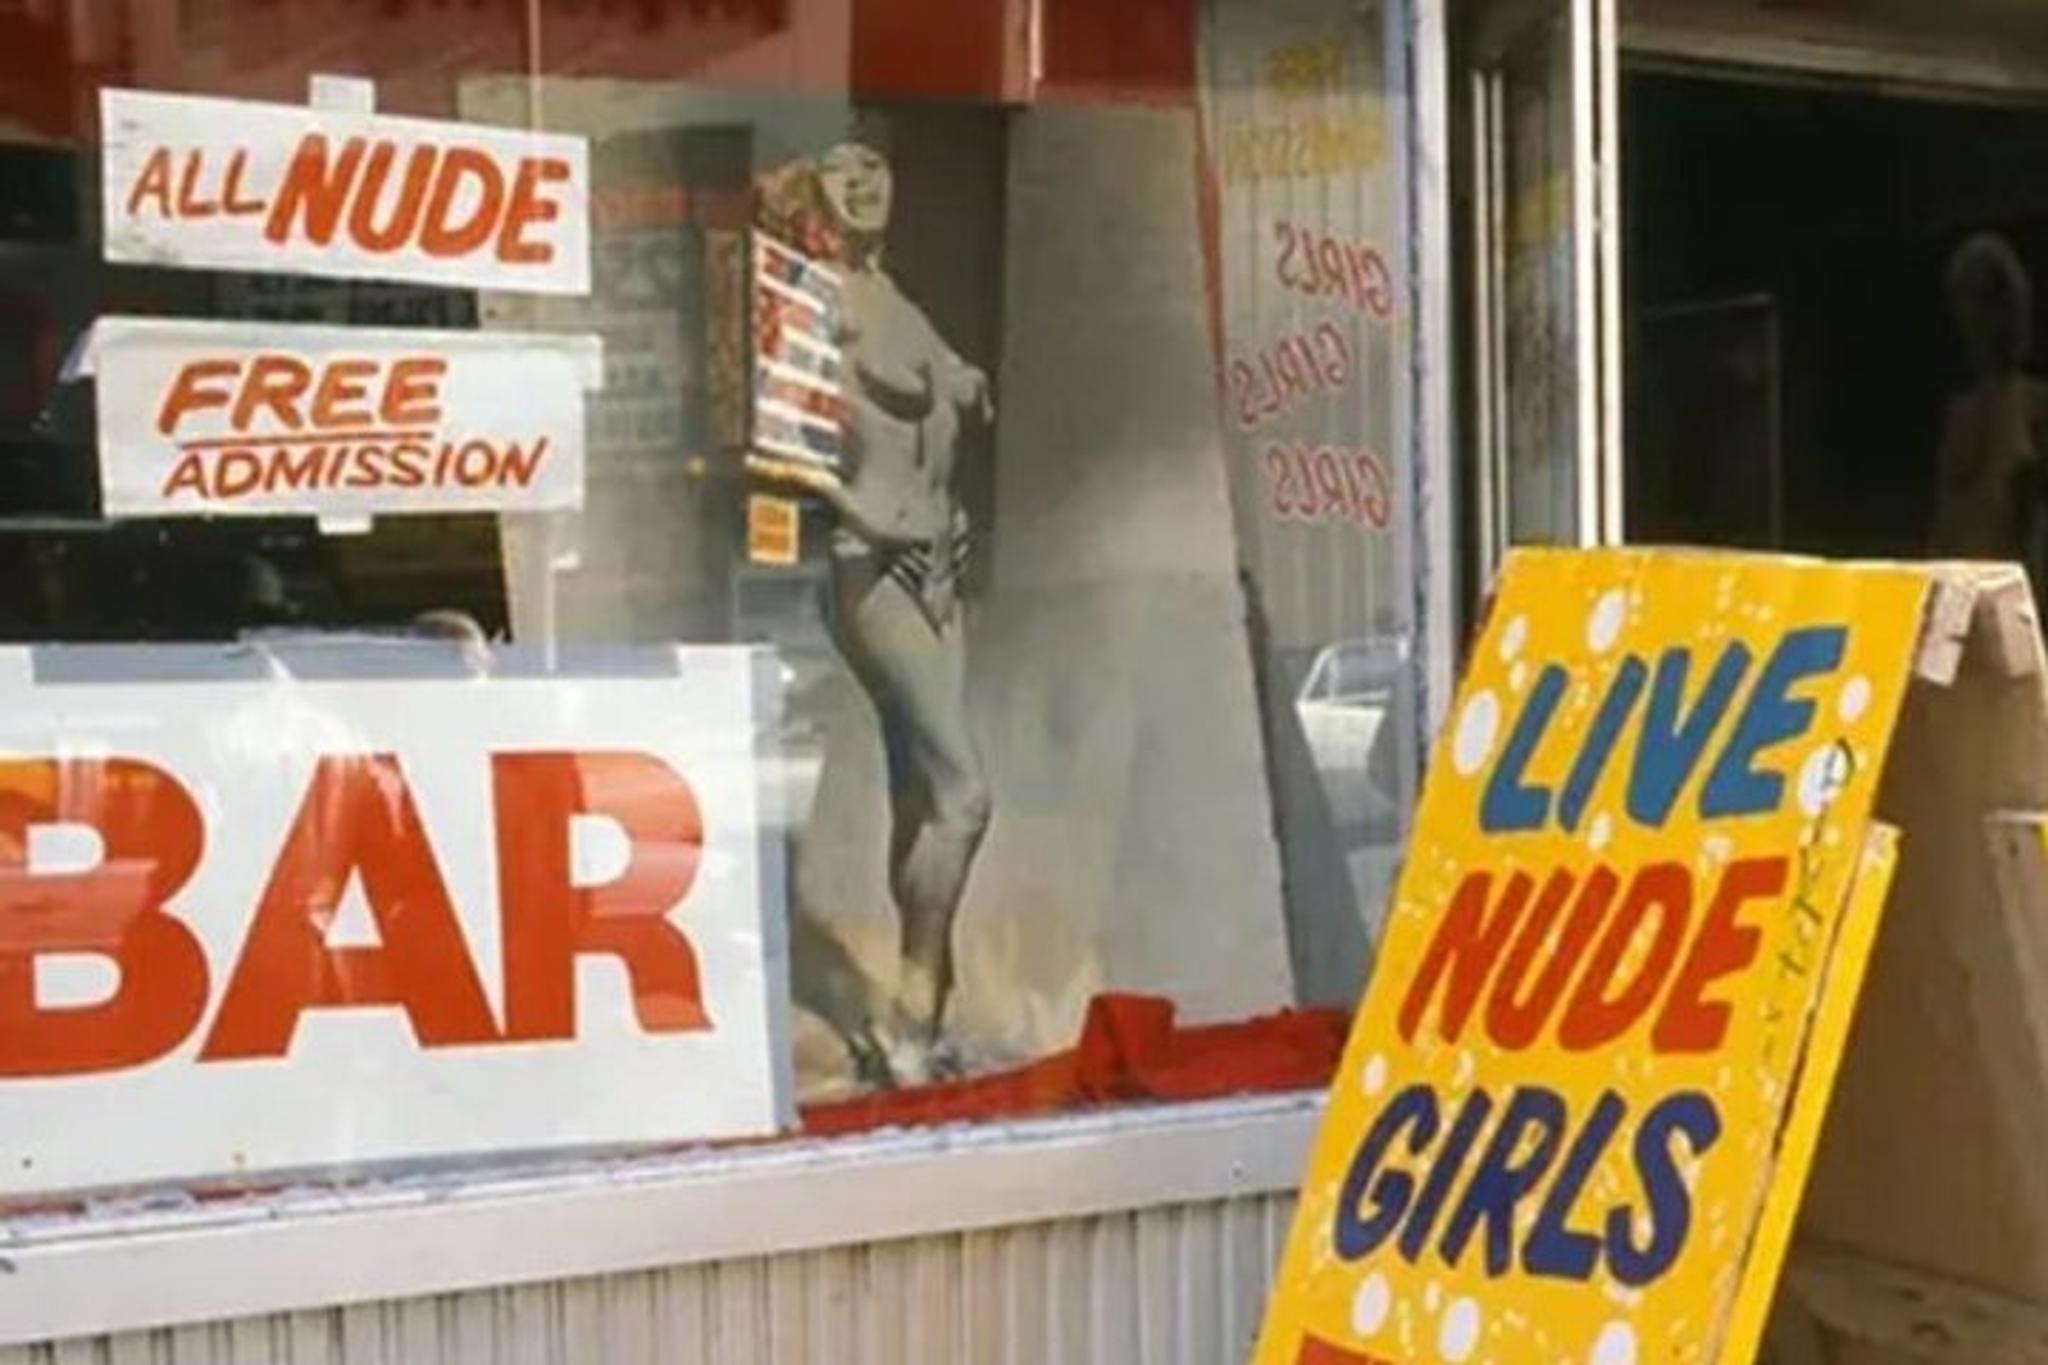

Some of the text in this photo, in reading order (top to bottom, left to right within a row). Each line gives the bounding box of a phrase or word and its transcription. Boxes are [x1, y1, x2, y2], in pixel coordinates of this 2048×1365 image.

[127, 133, 569, 264] ALL NUDE
[157, 356, 447, 435] FREE
[163, 437, 548, 498] ADMISSION
[1480, 626, 1848, 833] LIVE
[0, 749, 713, 1078] BAR
[1399, 858, 1789, 1054] NUDE
[1334, 1083, 1722, 1286] GIRLS
